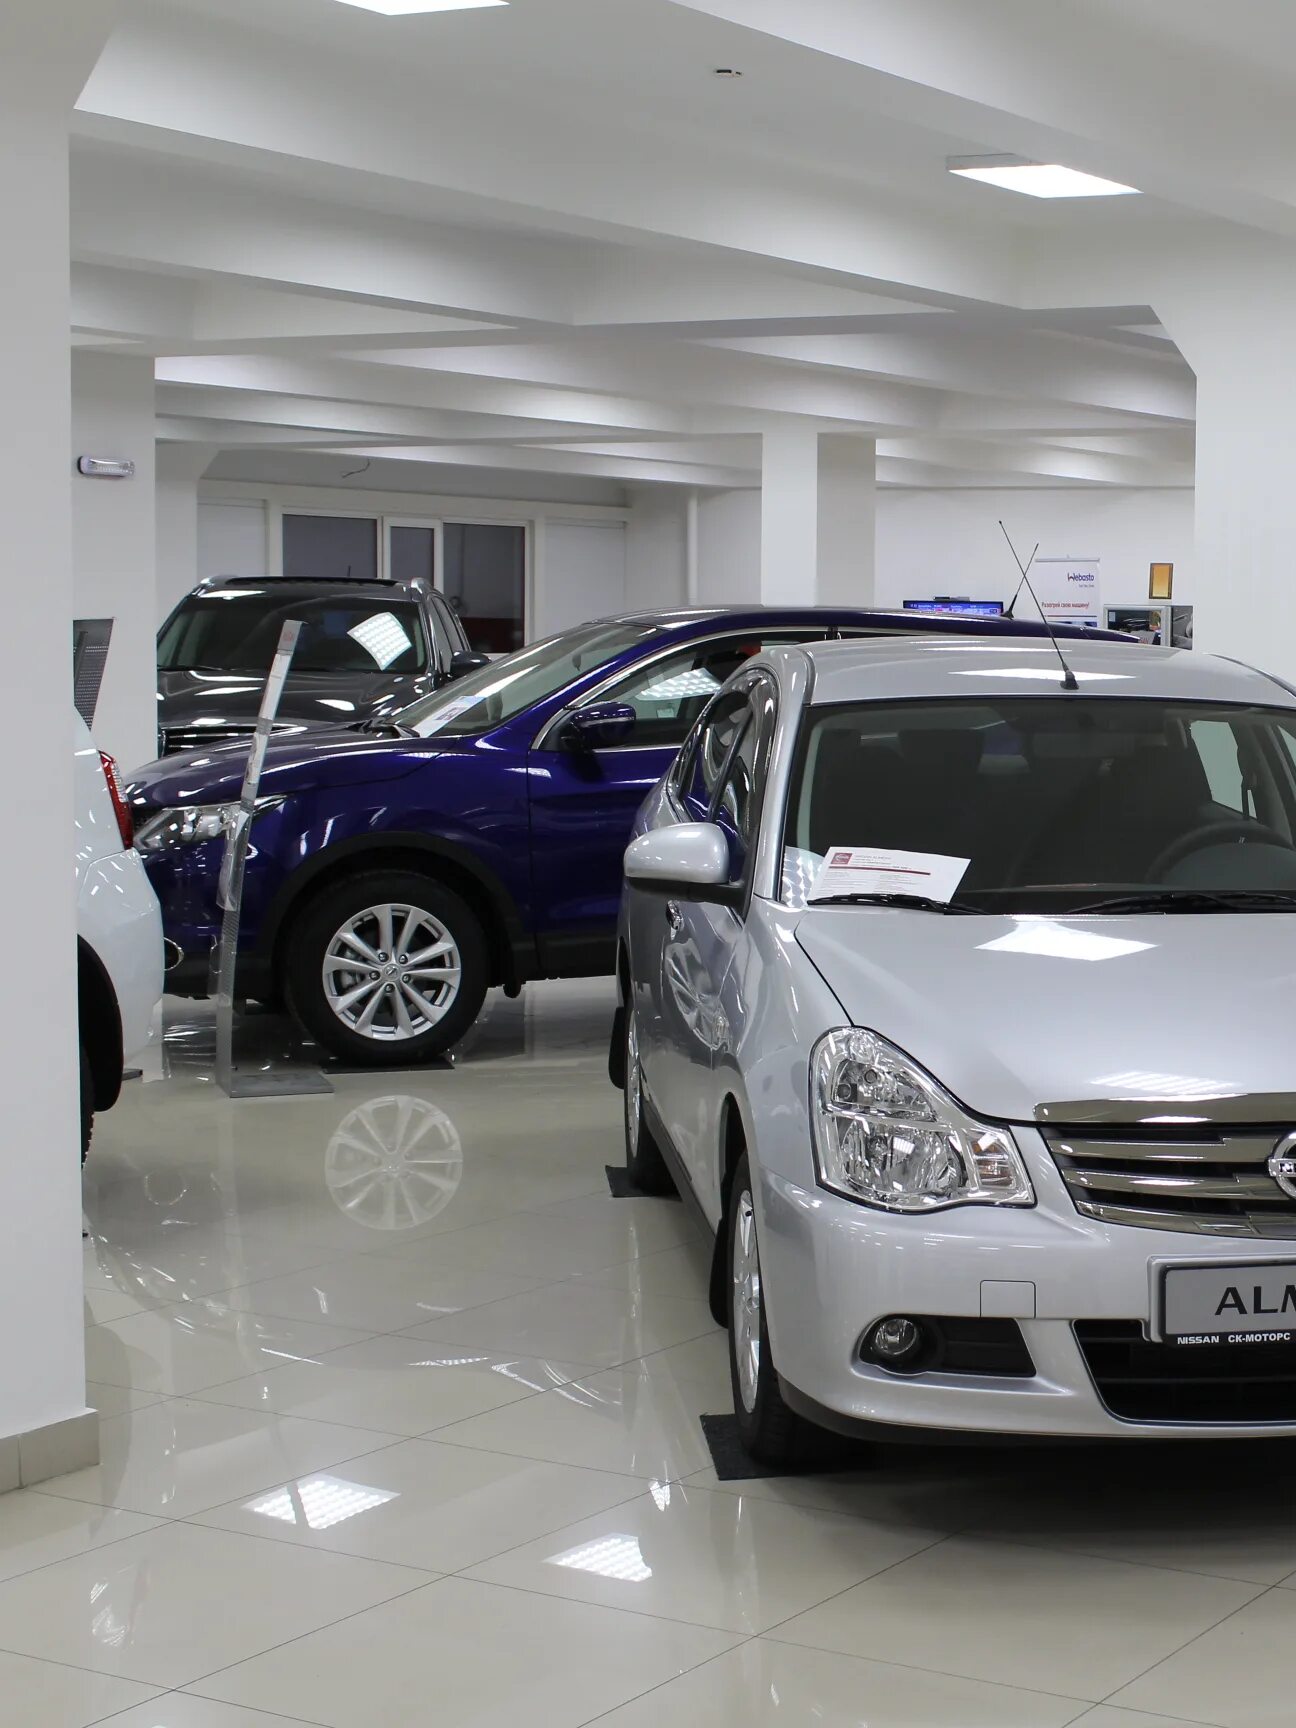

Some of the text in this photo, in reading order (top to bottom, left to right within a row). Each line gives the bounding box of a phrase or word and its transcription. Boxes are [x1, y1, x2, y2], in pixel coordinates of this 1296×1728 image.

[1067, 572, 1095, 581] Webasto
[1177, 1335, 1220, 1345] NISSAN
[1228, 1332, 1291, 1343] СК-МОТОРС
